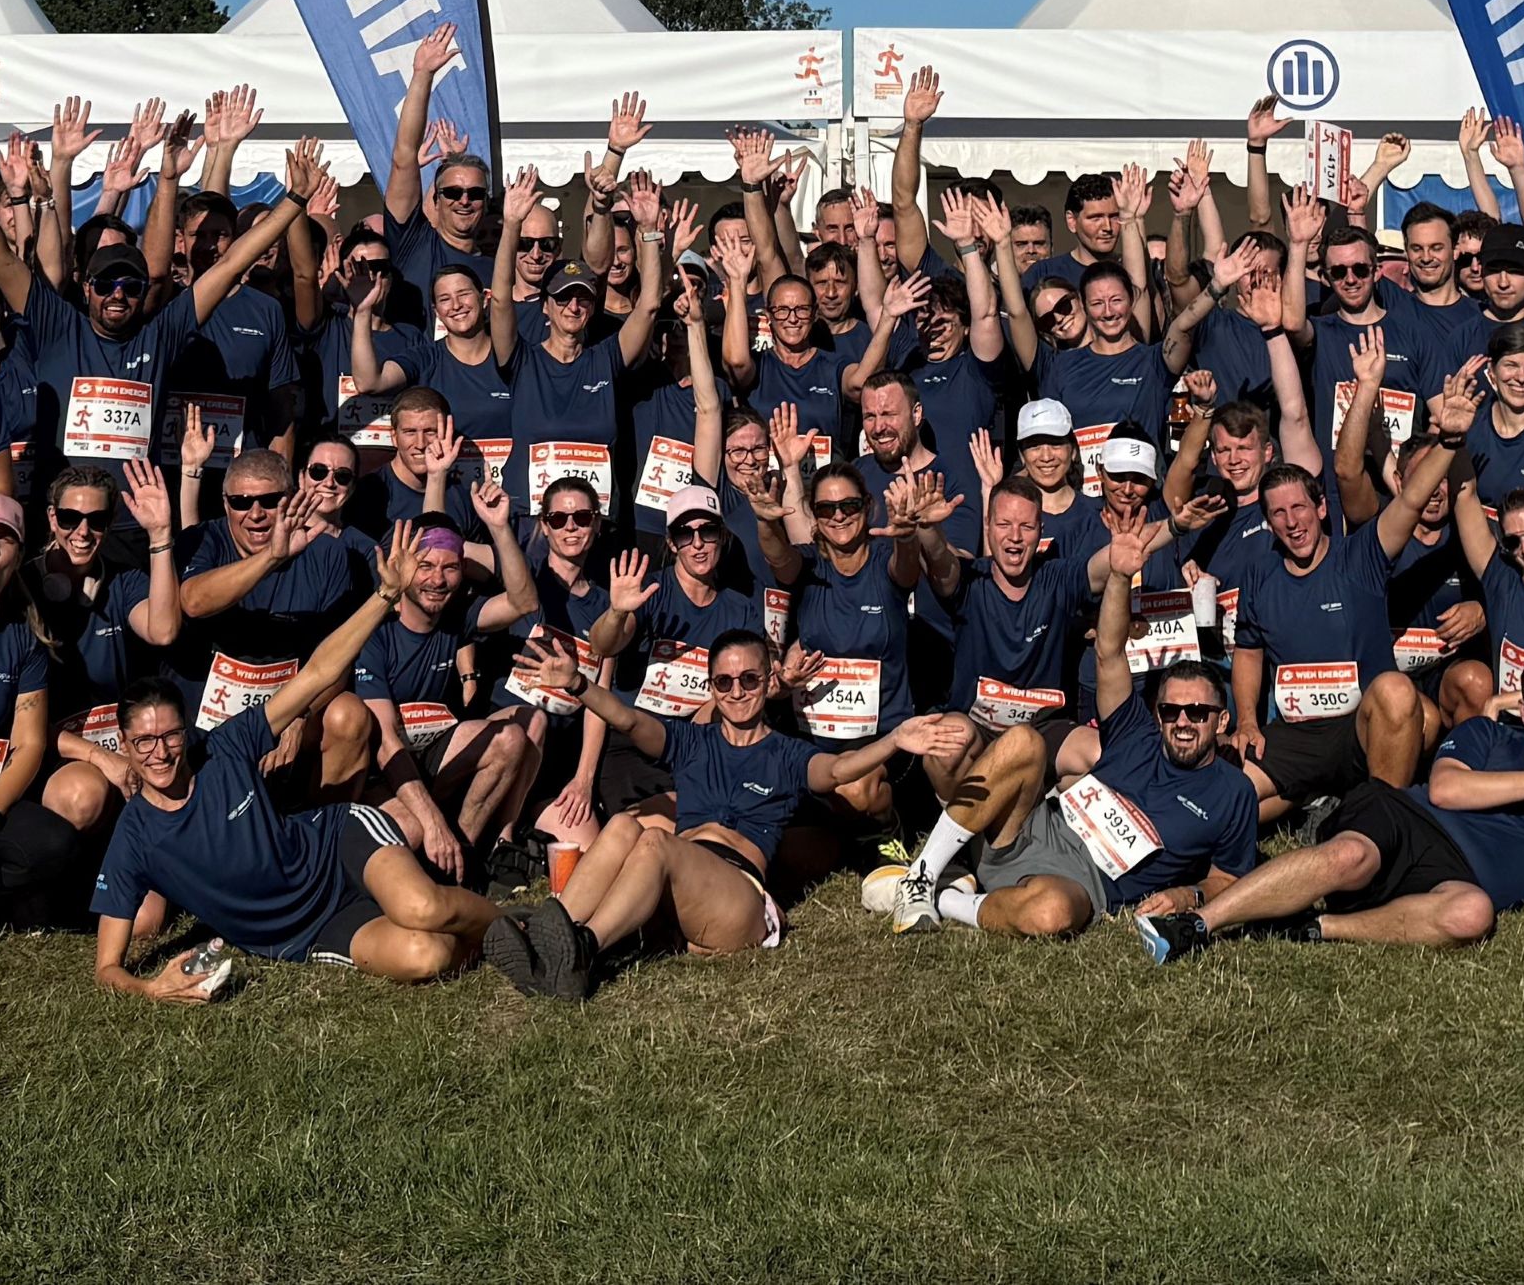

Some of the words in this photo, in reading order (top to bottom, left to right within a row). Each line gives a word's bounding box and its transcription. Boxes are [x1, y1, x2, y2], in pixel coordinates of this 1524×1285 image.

[103, 409, 141, 426] 337A
[826, 689, 866, 705] 354A
[1309, 692, 1350, 707] 350C
[1007, 708, 1035, 720] 343
[1103, 807, 1137, 849] 393A
